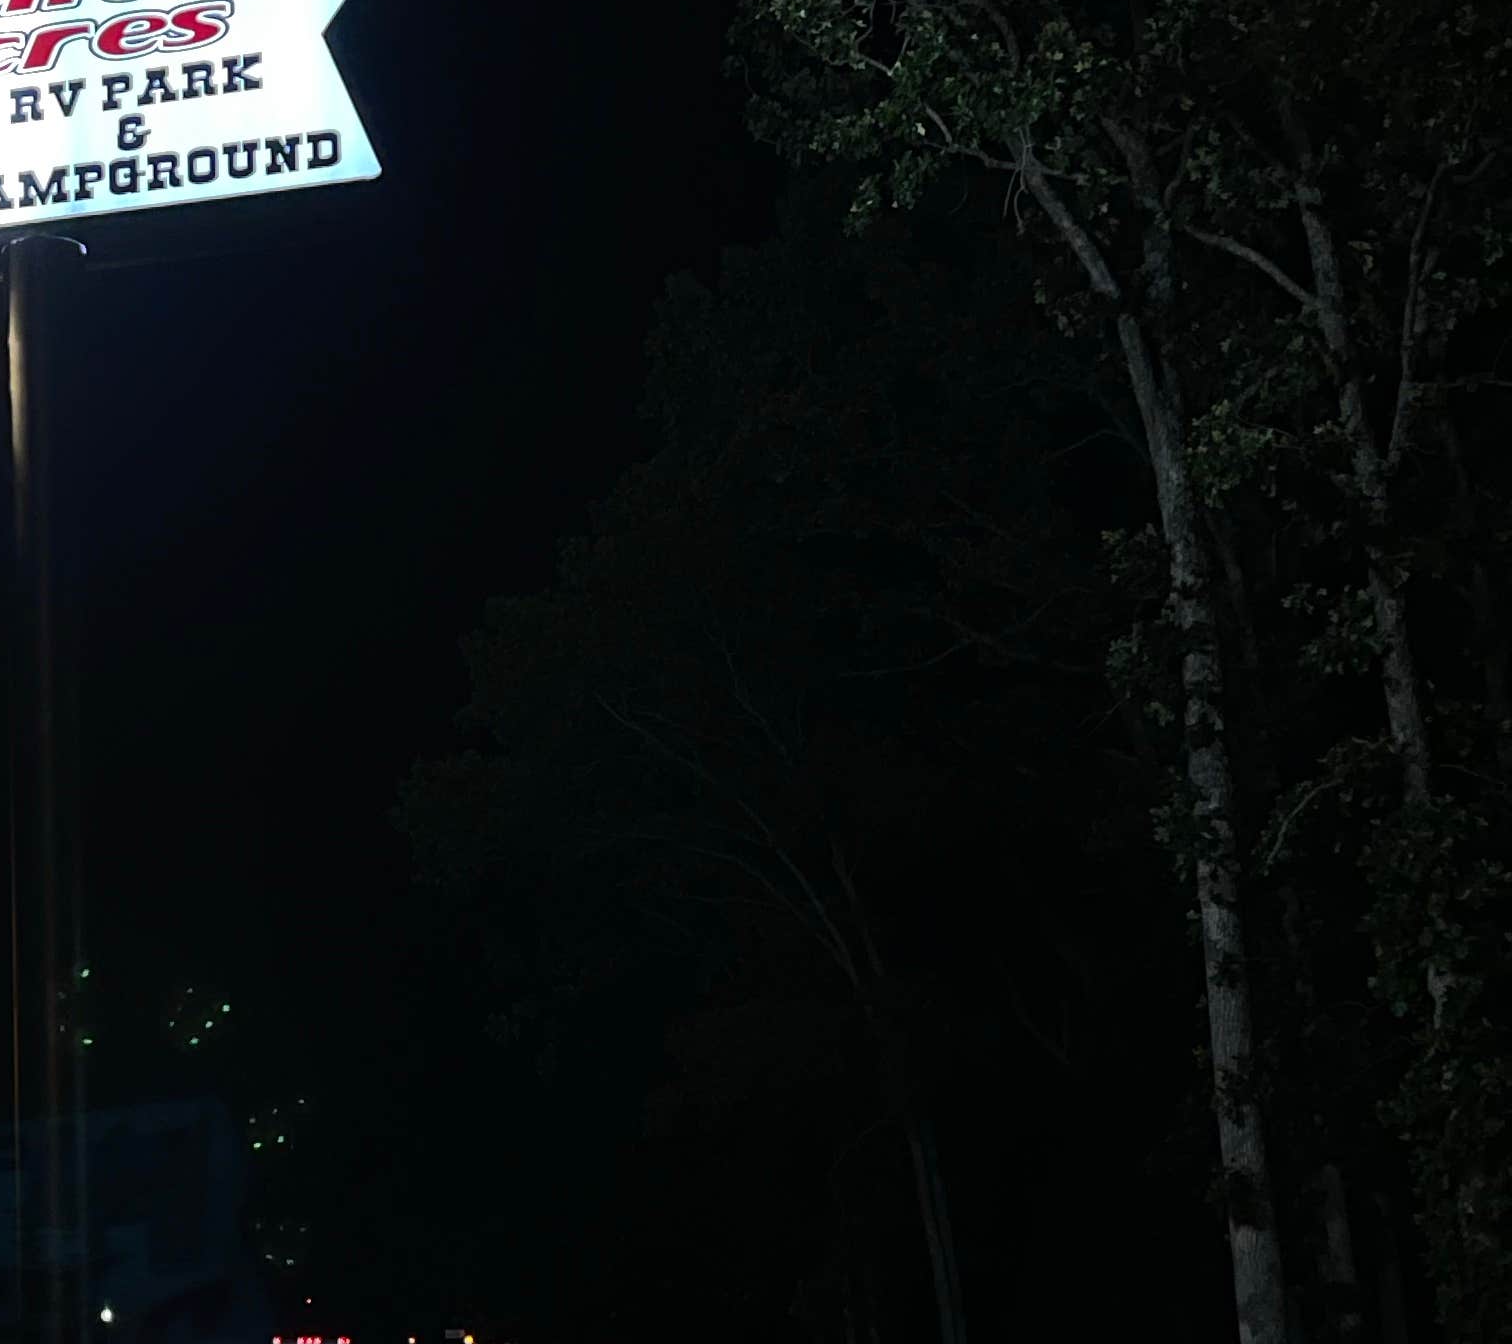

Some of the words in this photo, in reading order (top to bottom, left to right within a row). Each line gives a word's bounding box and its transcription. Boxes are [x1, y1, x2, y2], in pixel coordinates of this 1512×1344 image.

[10, 77, 86, 124] RV
[101, 52, 263, 111] PARK
[117, 113, 151, 151] &
